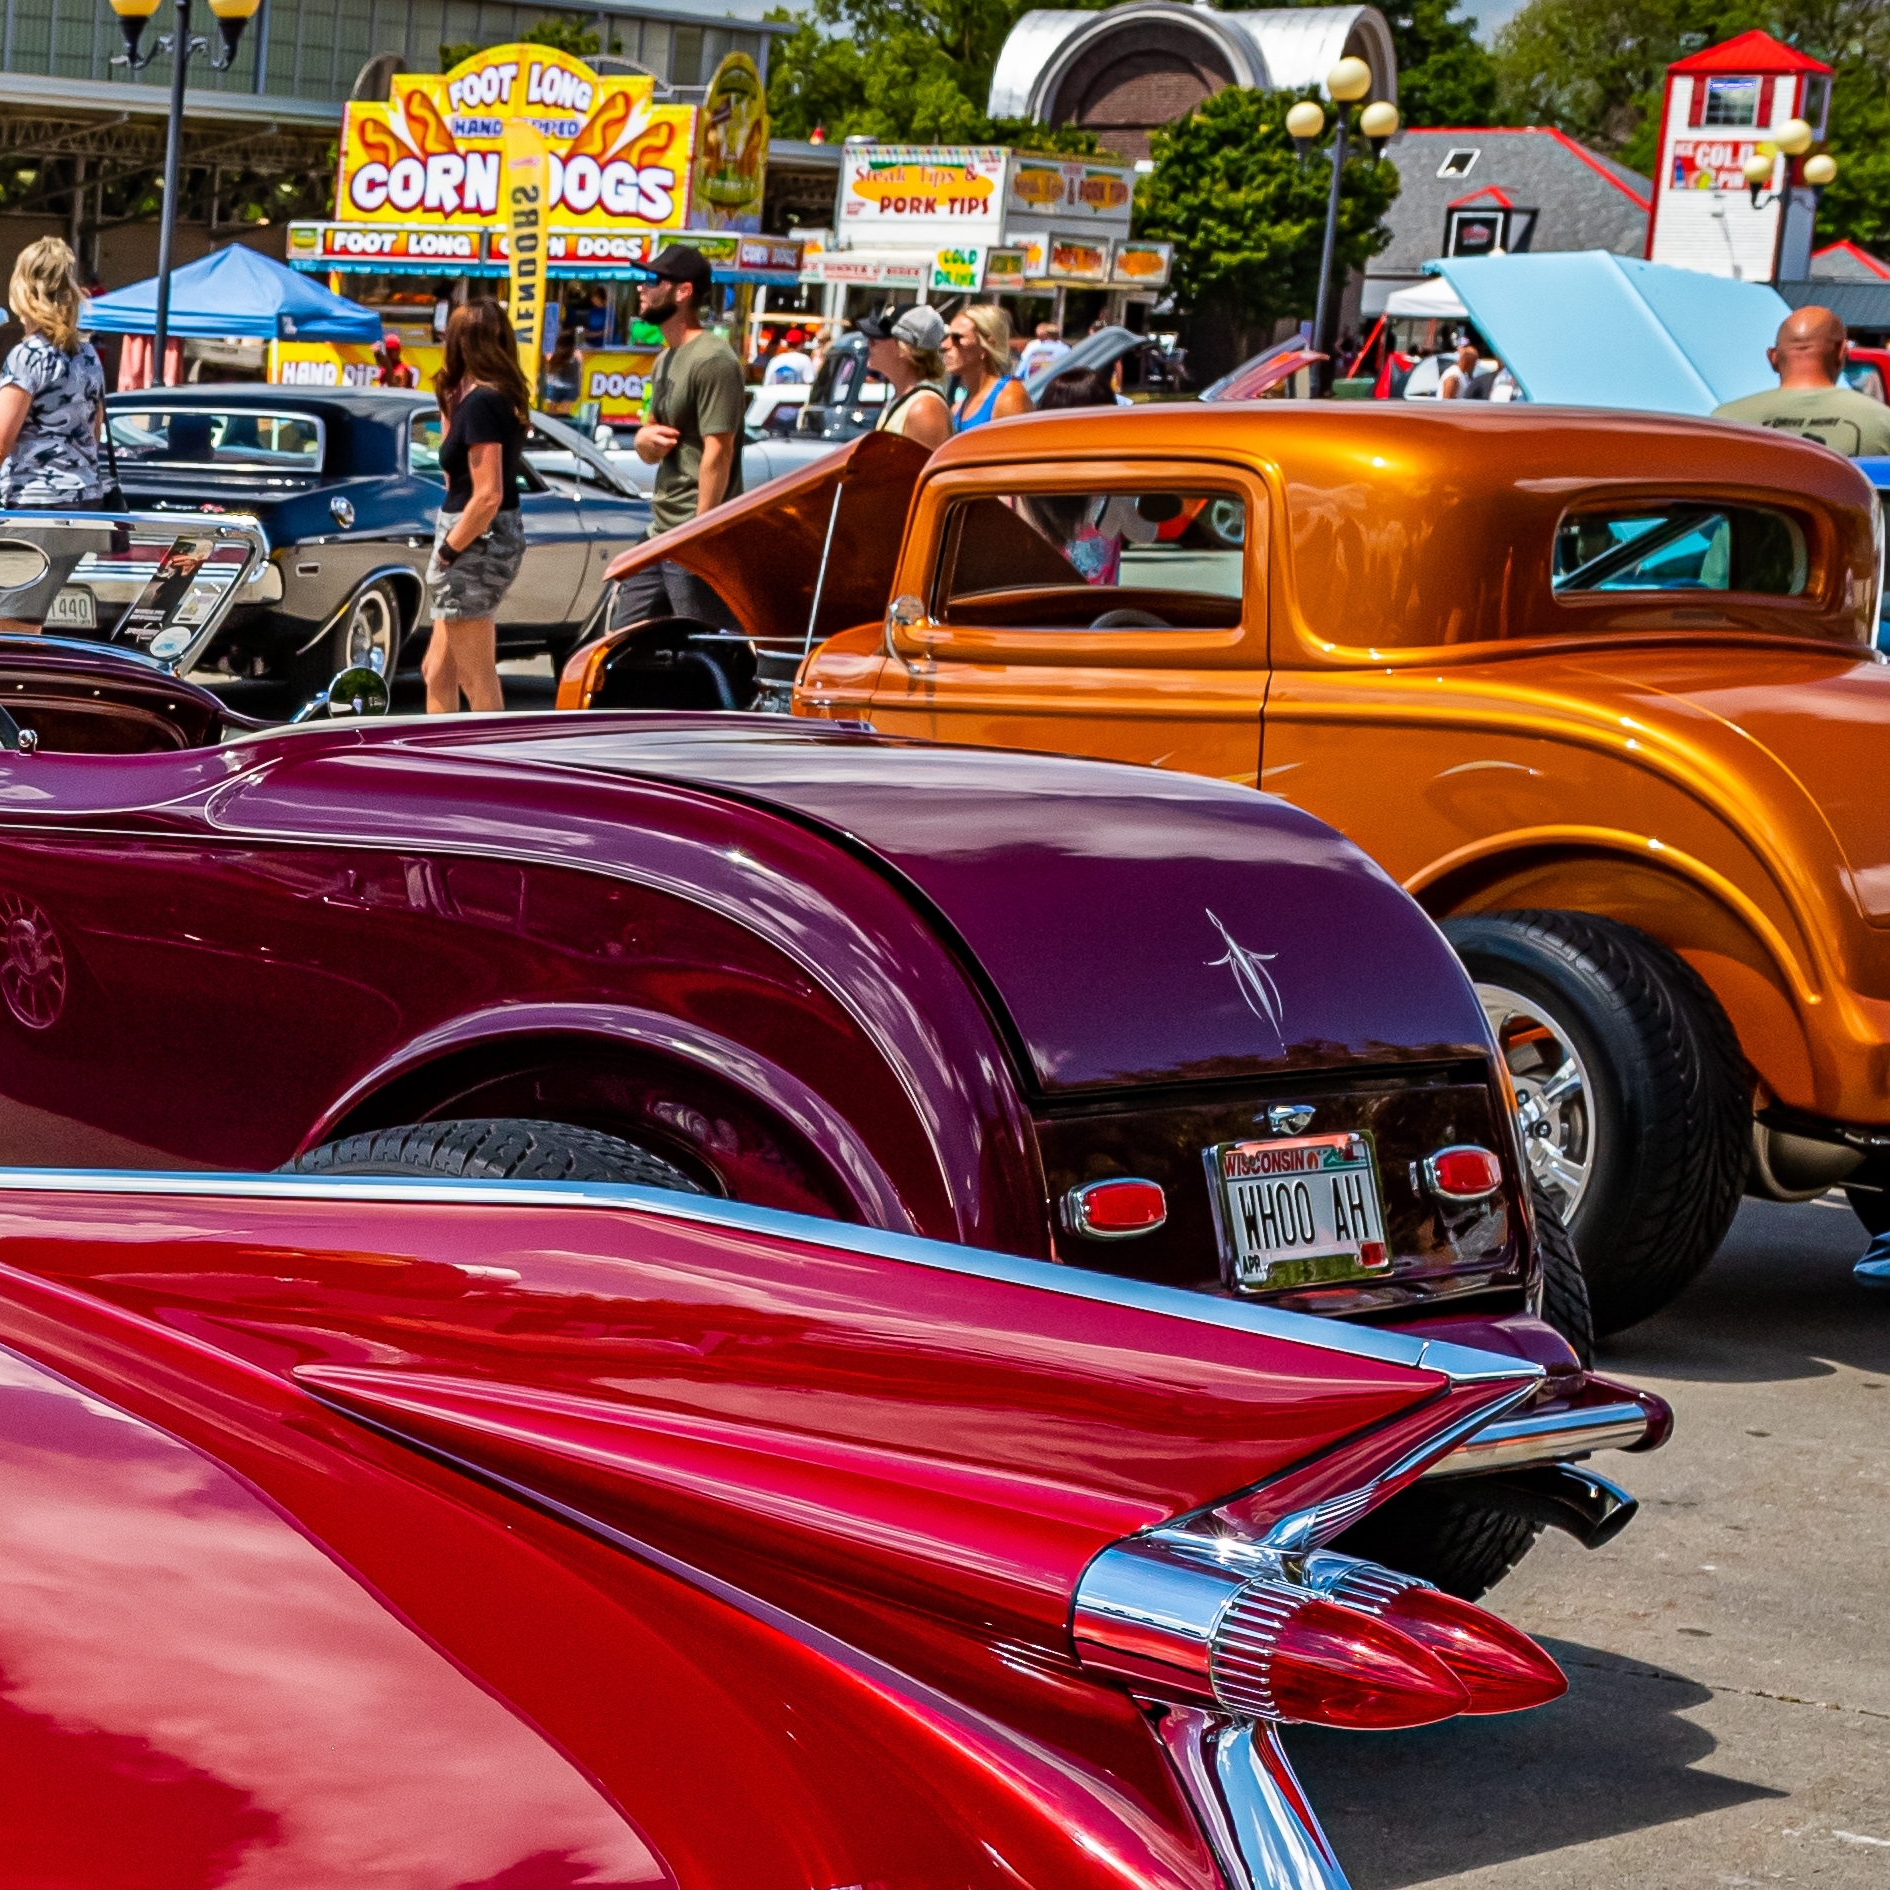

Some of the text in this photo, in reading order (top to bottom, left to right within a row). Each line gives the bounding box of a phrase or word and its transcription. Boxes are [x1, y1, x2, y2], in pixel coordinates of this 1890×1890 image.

[449, 62, 593, 112] FOOT LONG
[454, 119, 503, 135] HAND
[1695, 143, 1754, 168] COLD
[351, 152, 502, 214] CORN
[855, 166, 905, 183] Steak
[920, 165, 955, 188] Tips
[965, 164, 978, 181] &
[880, 195, 937, 214] PORK
[948, 196, 990, 215] TIPS
[333, 232, 397, 253] FOOT
[408, 234, 472, 255] LONG
[577, 236, 642, 259] DOGS
[944, 249, 977, 265] COLD
[934, 270, 976, 287] DRINK
[282, 361, 338, 386] HAND
[1225, 1151, 1305, 1177] WISCONSIN
[1238, 1175, 1369, 1250] WHOO AH
